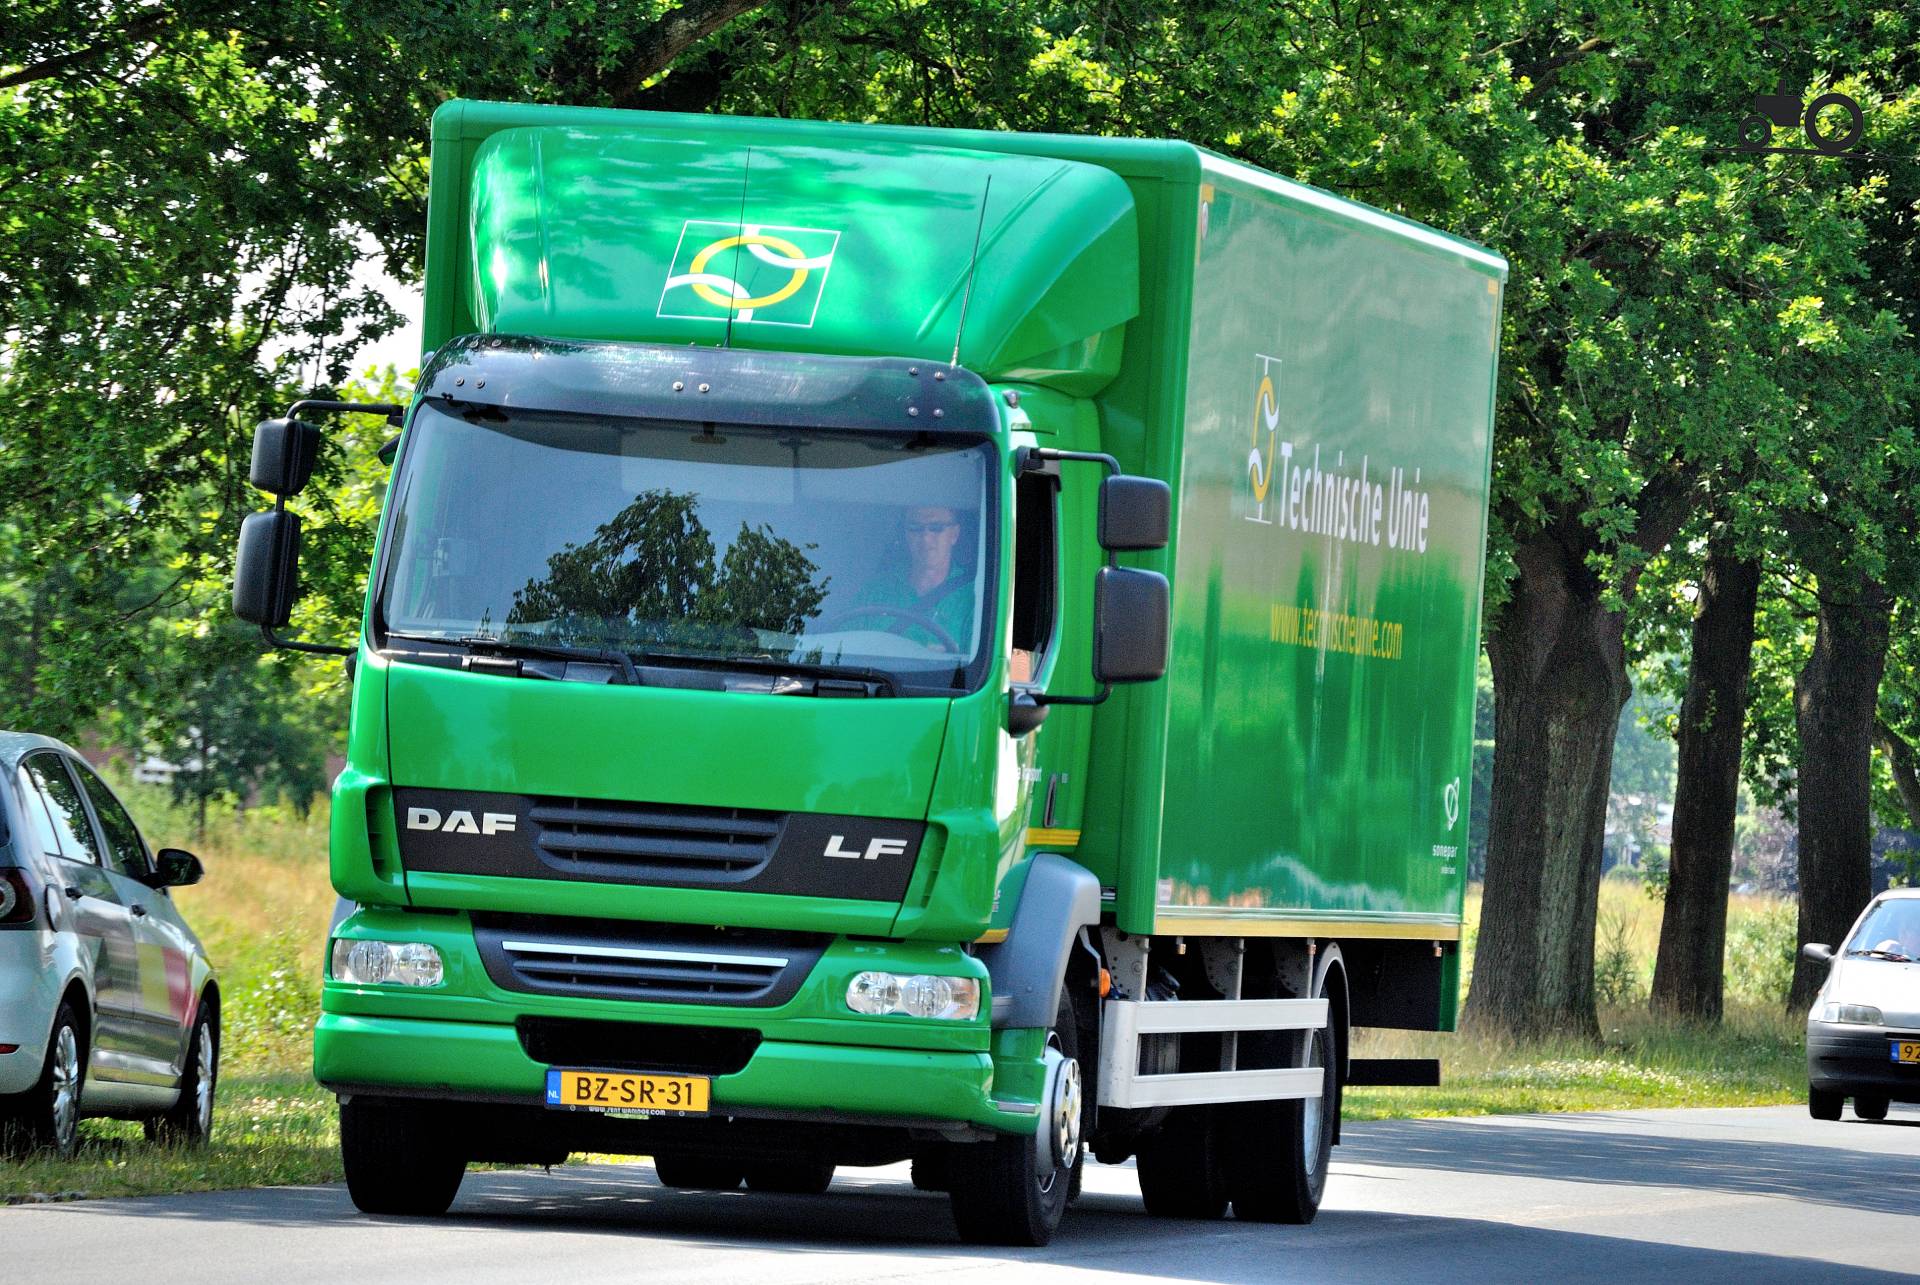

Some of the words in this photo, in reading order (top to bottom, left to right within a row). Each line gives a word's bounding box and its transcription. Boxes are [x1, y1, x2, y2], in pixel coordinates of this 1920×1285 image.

[1279, 441, 1383, 547] Technische
[1387, 466, 1430, 554] Unie
[406, 806, 517, 836] DAF
[823, 834, 908, 861] LF
[548, 1089, 560, 1099] NL
[575, 1076, 693, 1106] BZ-SR-31
